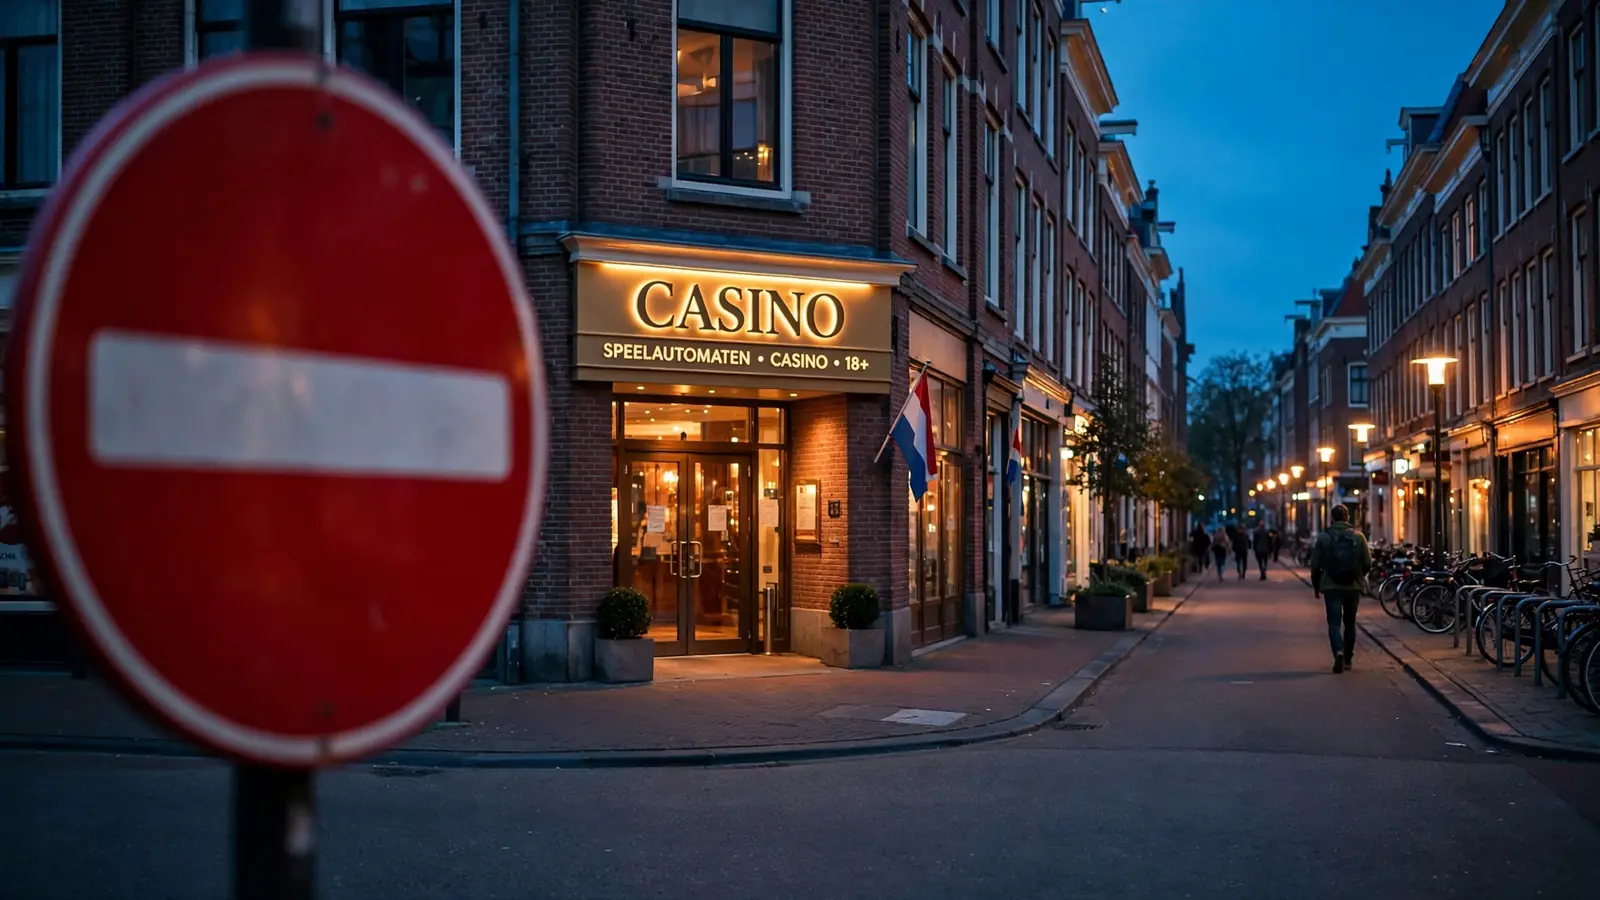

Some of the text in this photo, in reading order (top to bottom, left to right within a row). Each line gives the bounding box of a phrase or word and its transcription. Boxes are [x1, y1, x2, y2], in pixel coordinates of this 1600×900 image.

[637, 280, 845, 338] CASINO
[603, 342, 869, 370] SPEELAUTOMATEN CASINO 18+
